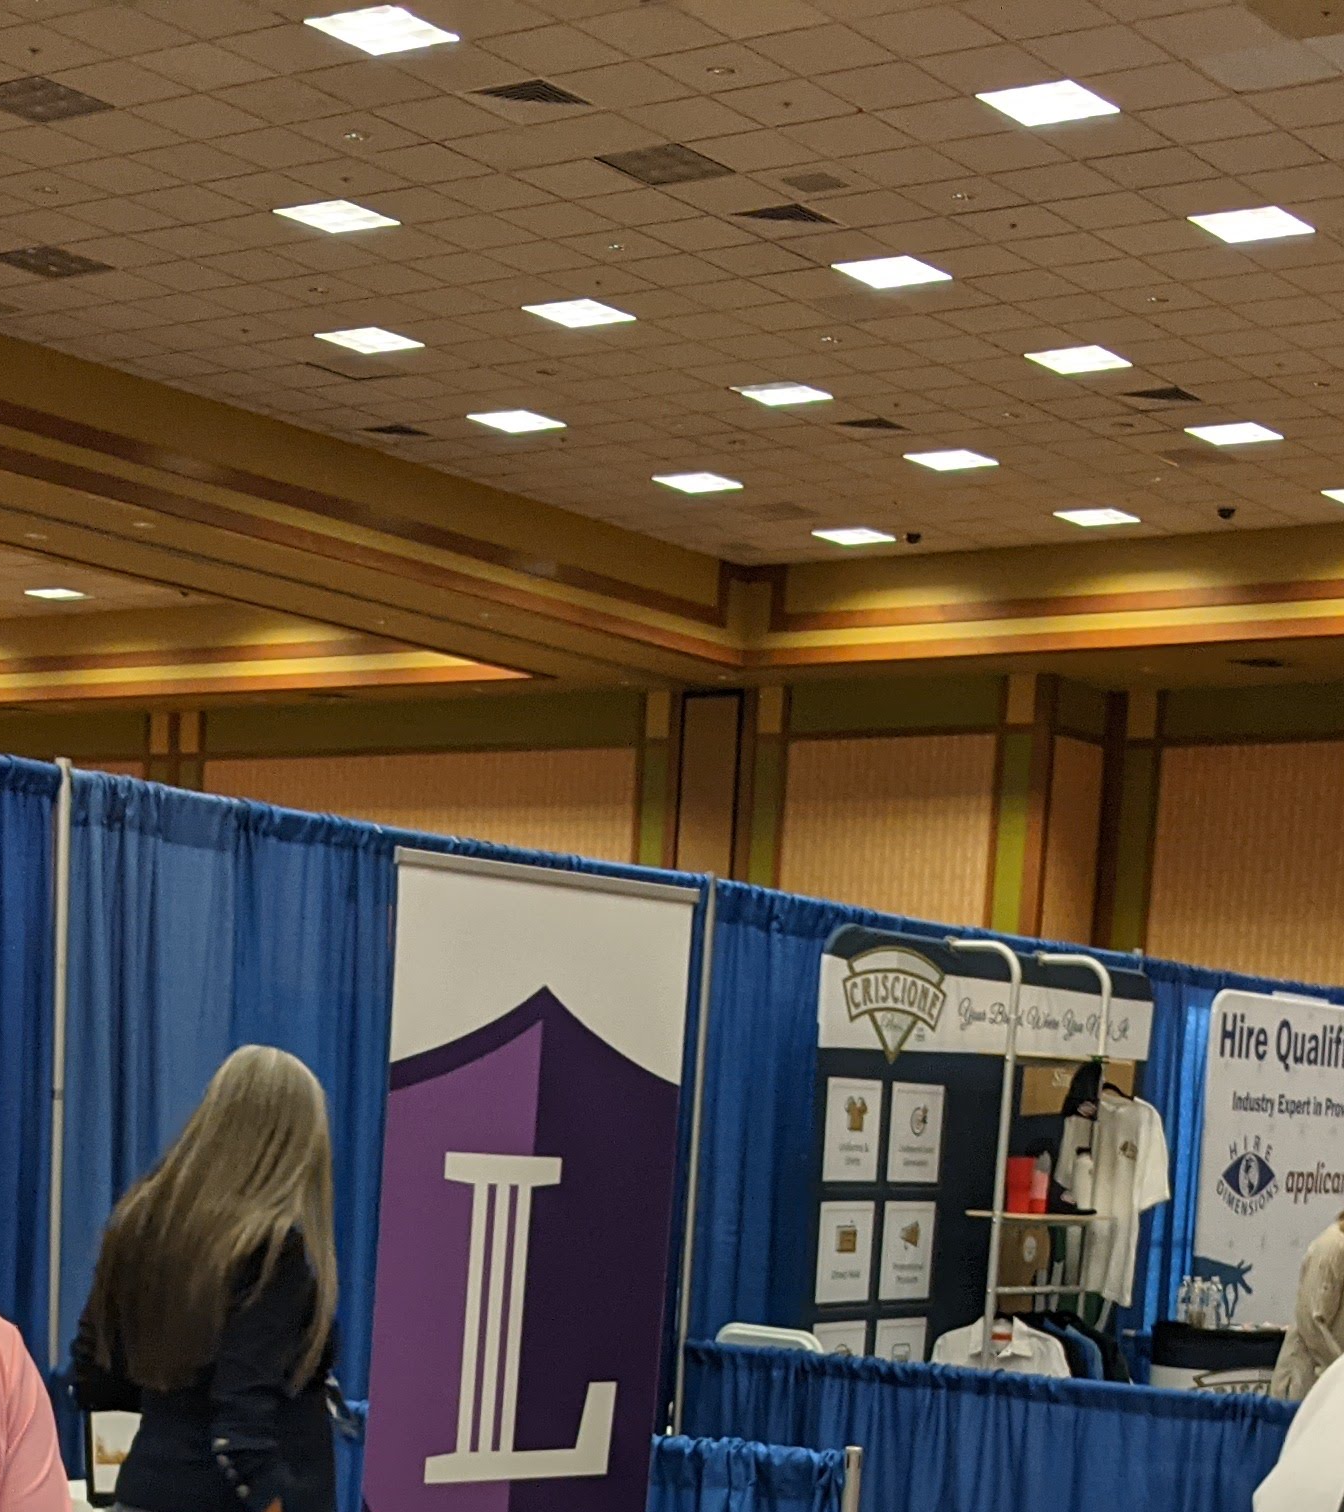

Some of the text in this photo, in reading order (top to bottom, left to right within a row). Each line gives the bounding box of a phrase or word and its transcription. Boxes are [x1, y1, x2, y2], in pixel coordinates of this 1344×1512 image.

[847, 973, 942, 1023] CRISCIONE
[1219, 1011, 1268, 1061] Hire
[1232, 1091, 1275, 1117] Industry
[1277, 1094, 1312, 1121] Expert
[1313, 1096, 1323, 1116] in
[1229, 1134, 1273, 1163] HIRE
[1216, 1178, 1280, 1216] DIMENSIONS
[424, 1151, 618, 1484] L
